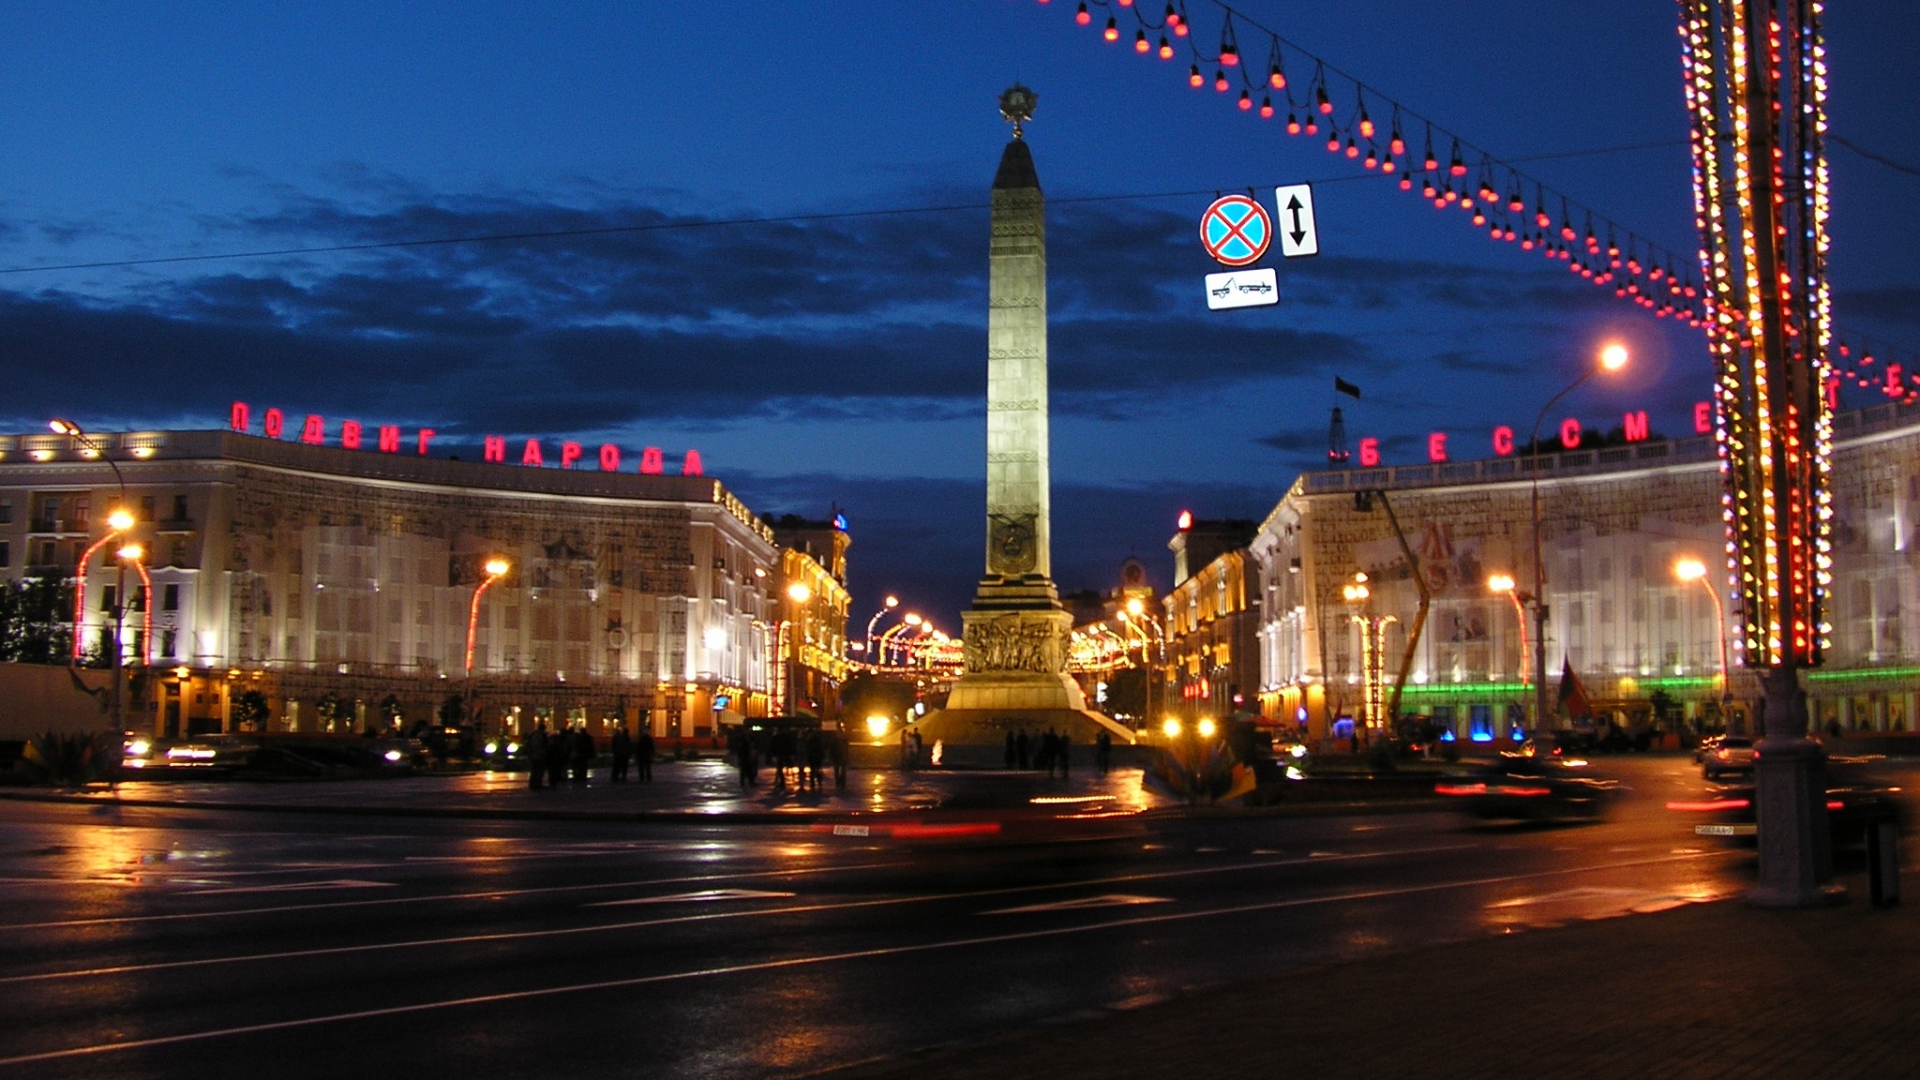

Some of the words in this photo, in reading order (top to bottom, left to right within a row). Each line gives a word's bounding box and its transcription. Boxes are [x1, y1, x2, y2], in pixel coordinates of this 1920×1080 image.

[231, 402, 436, 455] ПОДВИГ
[484, 436, 704, 476] НАРОДА
[1359, 365, 1905, 467] БЕССМЕТЕ
